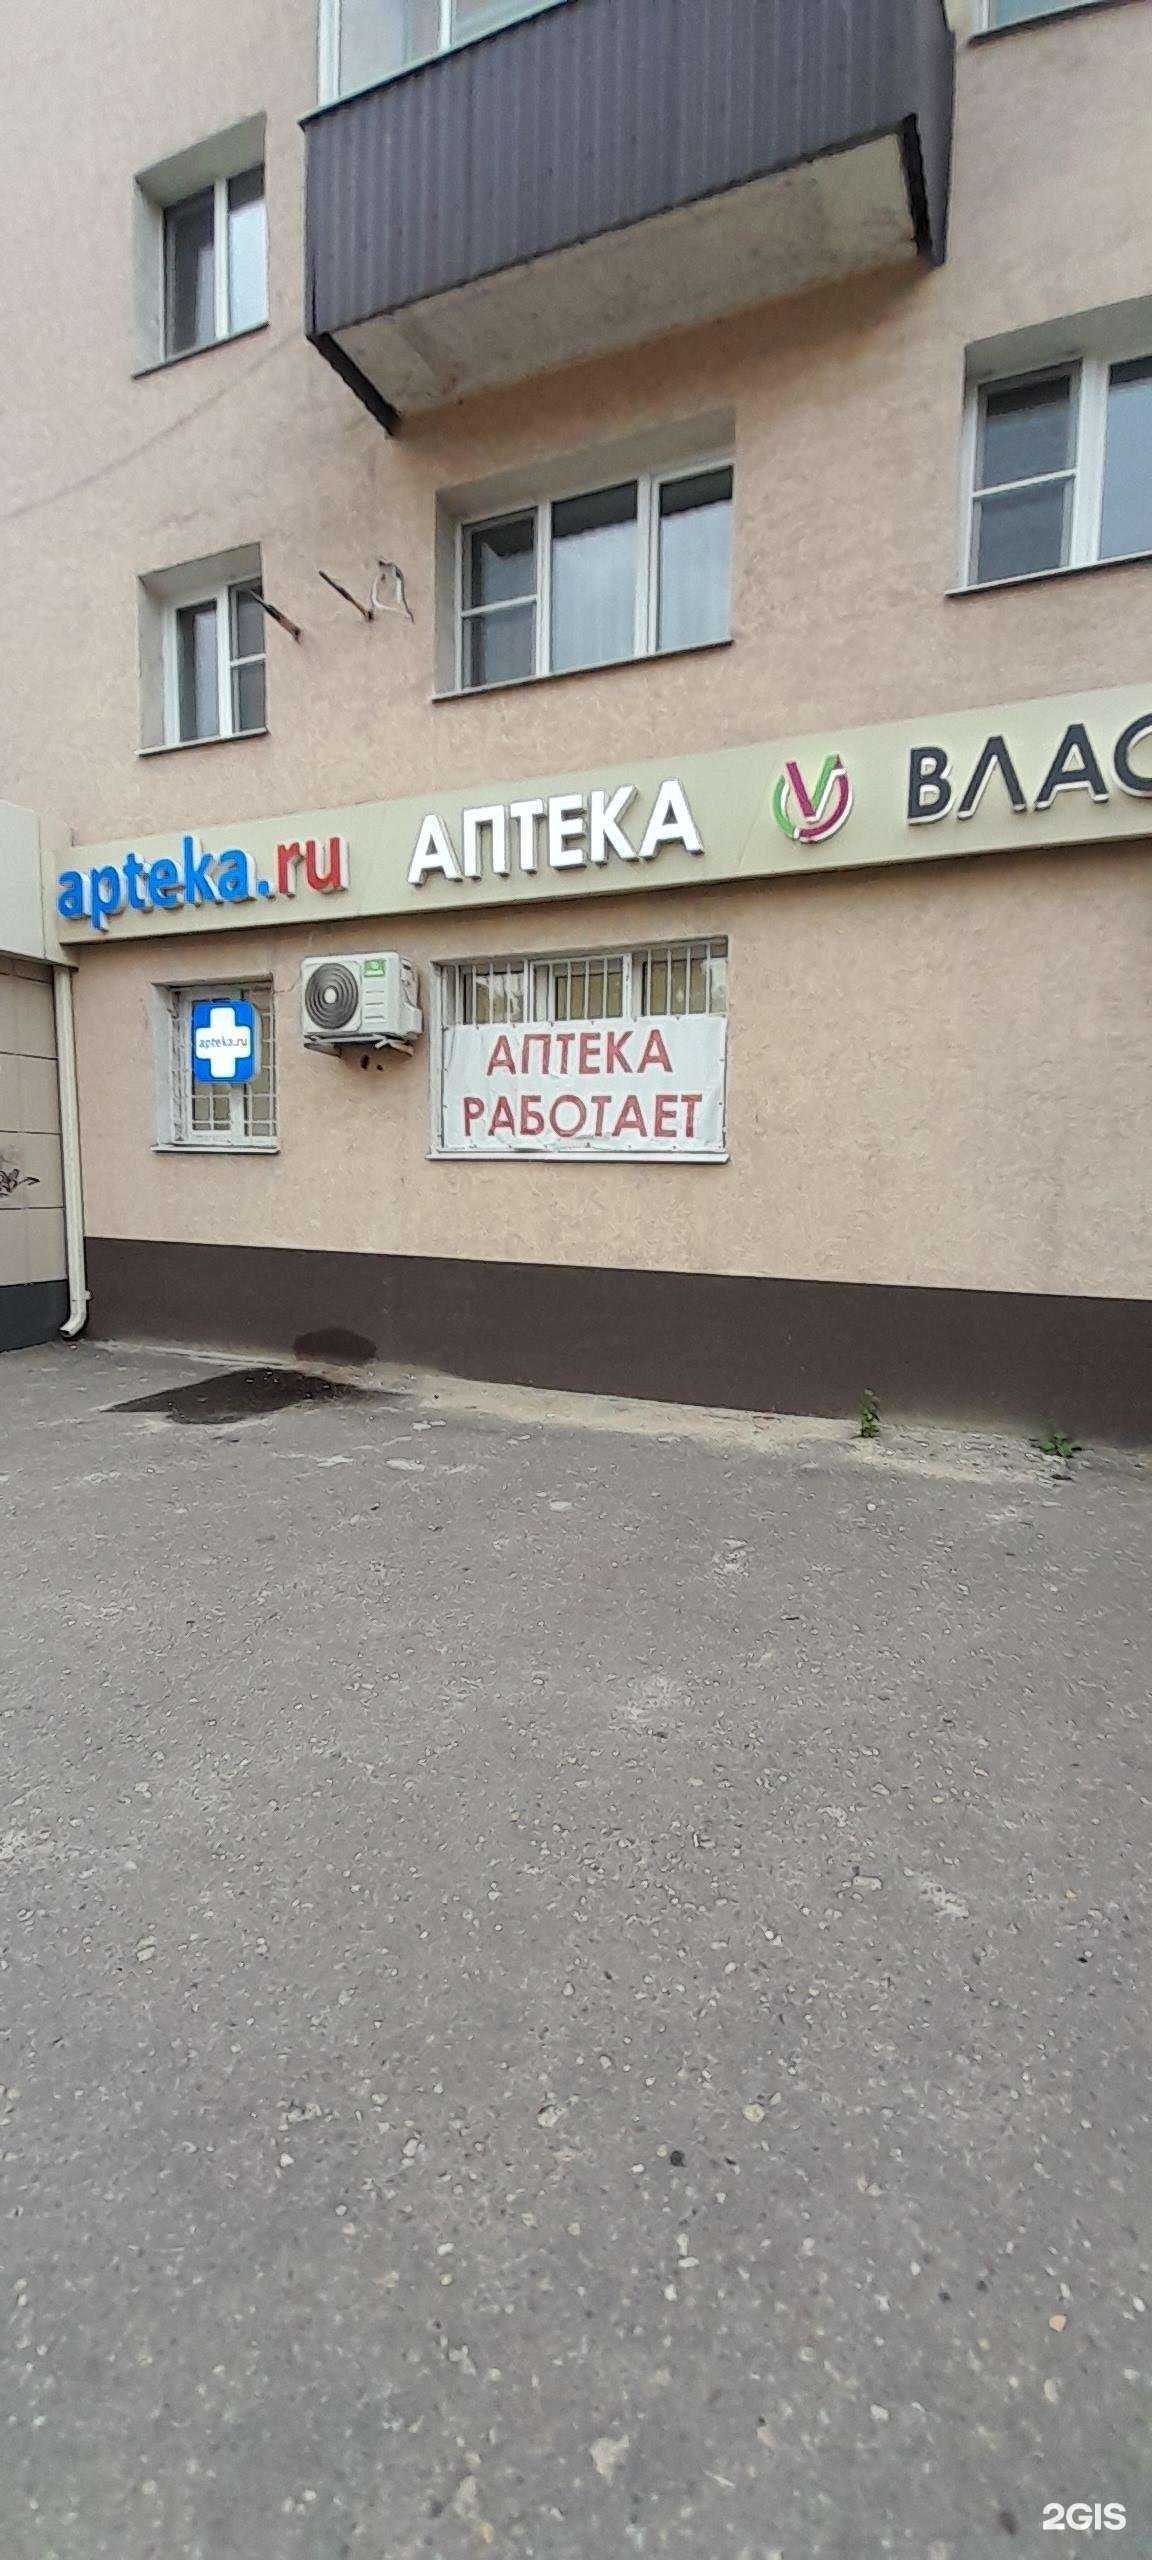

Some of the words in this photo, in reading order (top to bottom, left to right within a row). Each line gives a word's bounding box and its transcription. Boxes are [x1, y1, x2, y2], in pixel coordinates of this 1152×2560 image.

[407, 776, 704, 885] АПТЕКА
[57, 834, 346, 931] apteka.ru
[486, 1028, 673, 1076] АПТЕКА
[463, 1094, 703, 1138] РАБОТАЕТ
